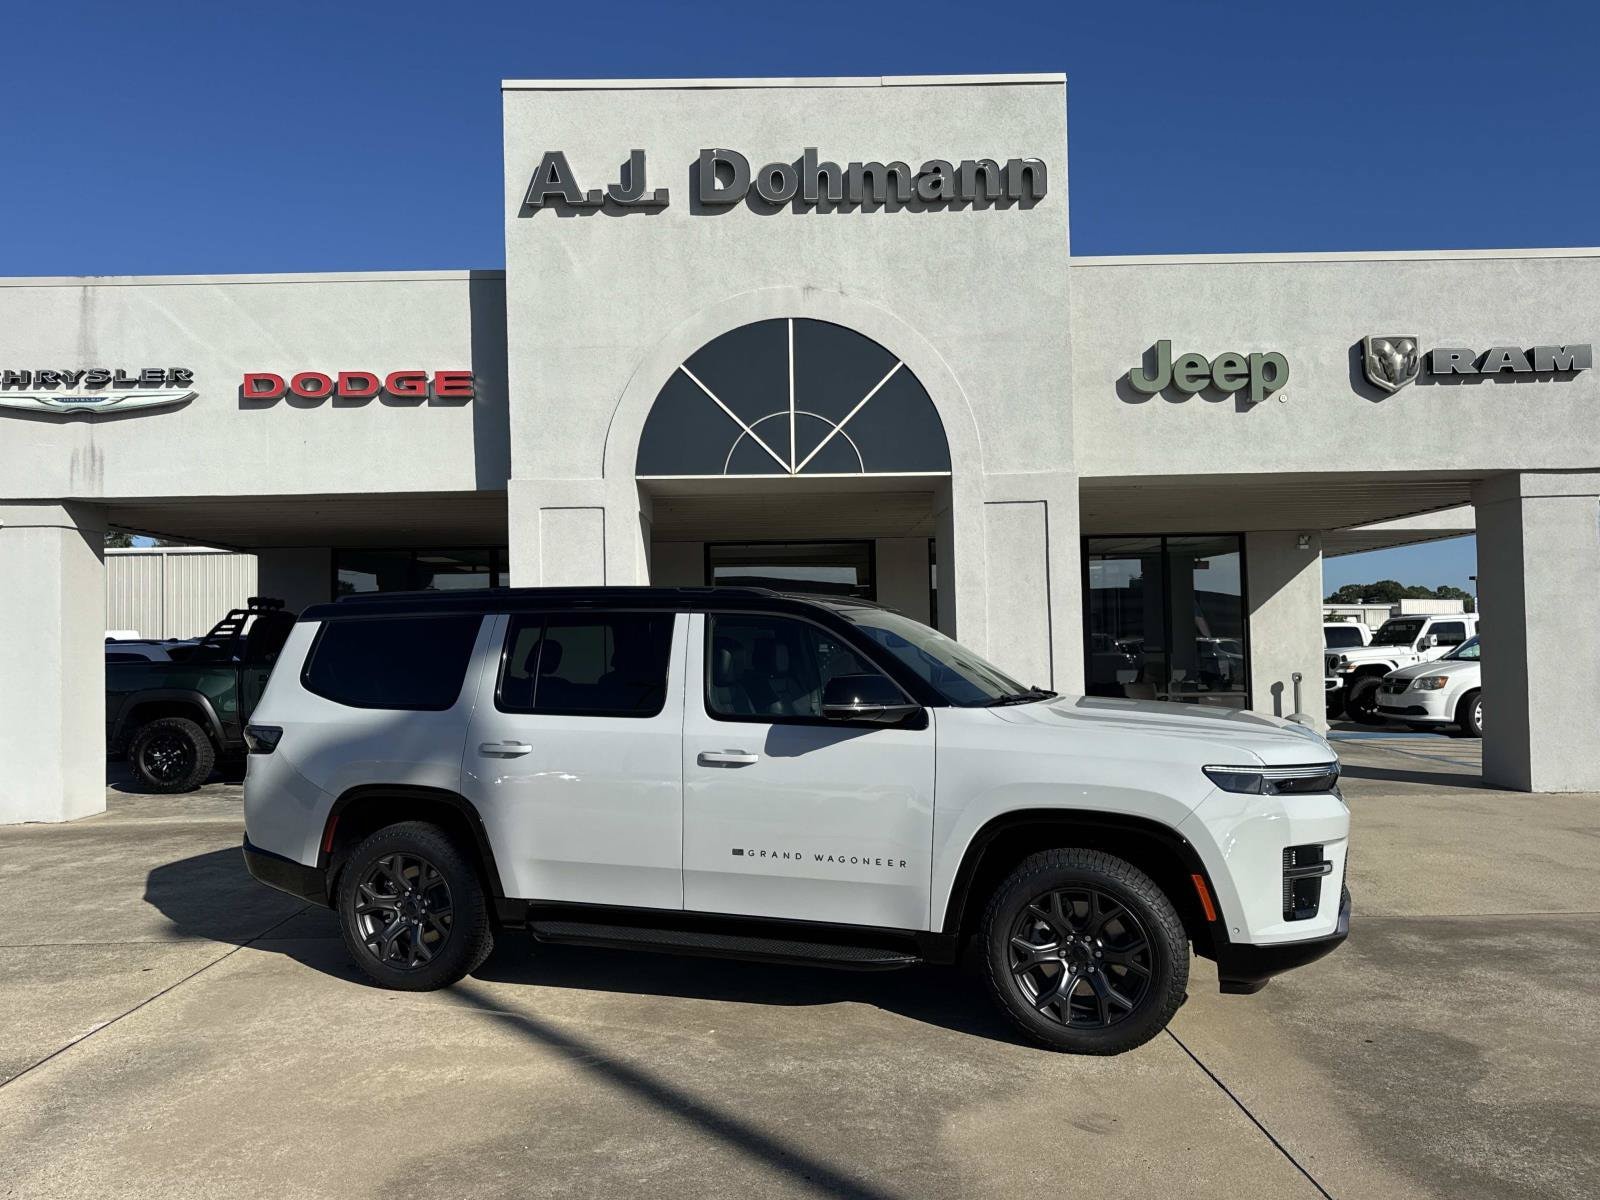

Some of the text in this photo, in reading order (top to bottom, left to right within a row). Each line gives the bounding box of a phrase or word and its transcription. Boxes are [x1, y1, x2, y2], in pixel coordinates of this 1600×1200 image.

[525, 147, 1047, 207] A.J. Dohmann
[1130, 339, 1290, 402] Jeep
[1432, 344, 1592, 375] RAM
[0, 367, 194, 386] HRYSLER
[243, 370, 474, 399] DODGE
[748, 849, 907, 868] GRAND WAGONEER
